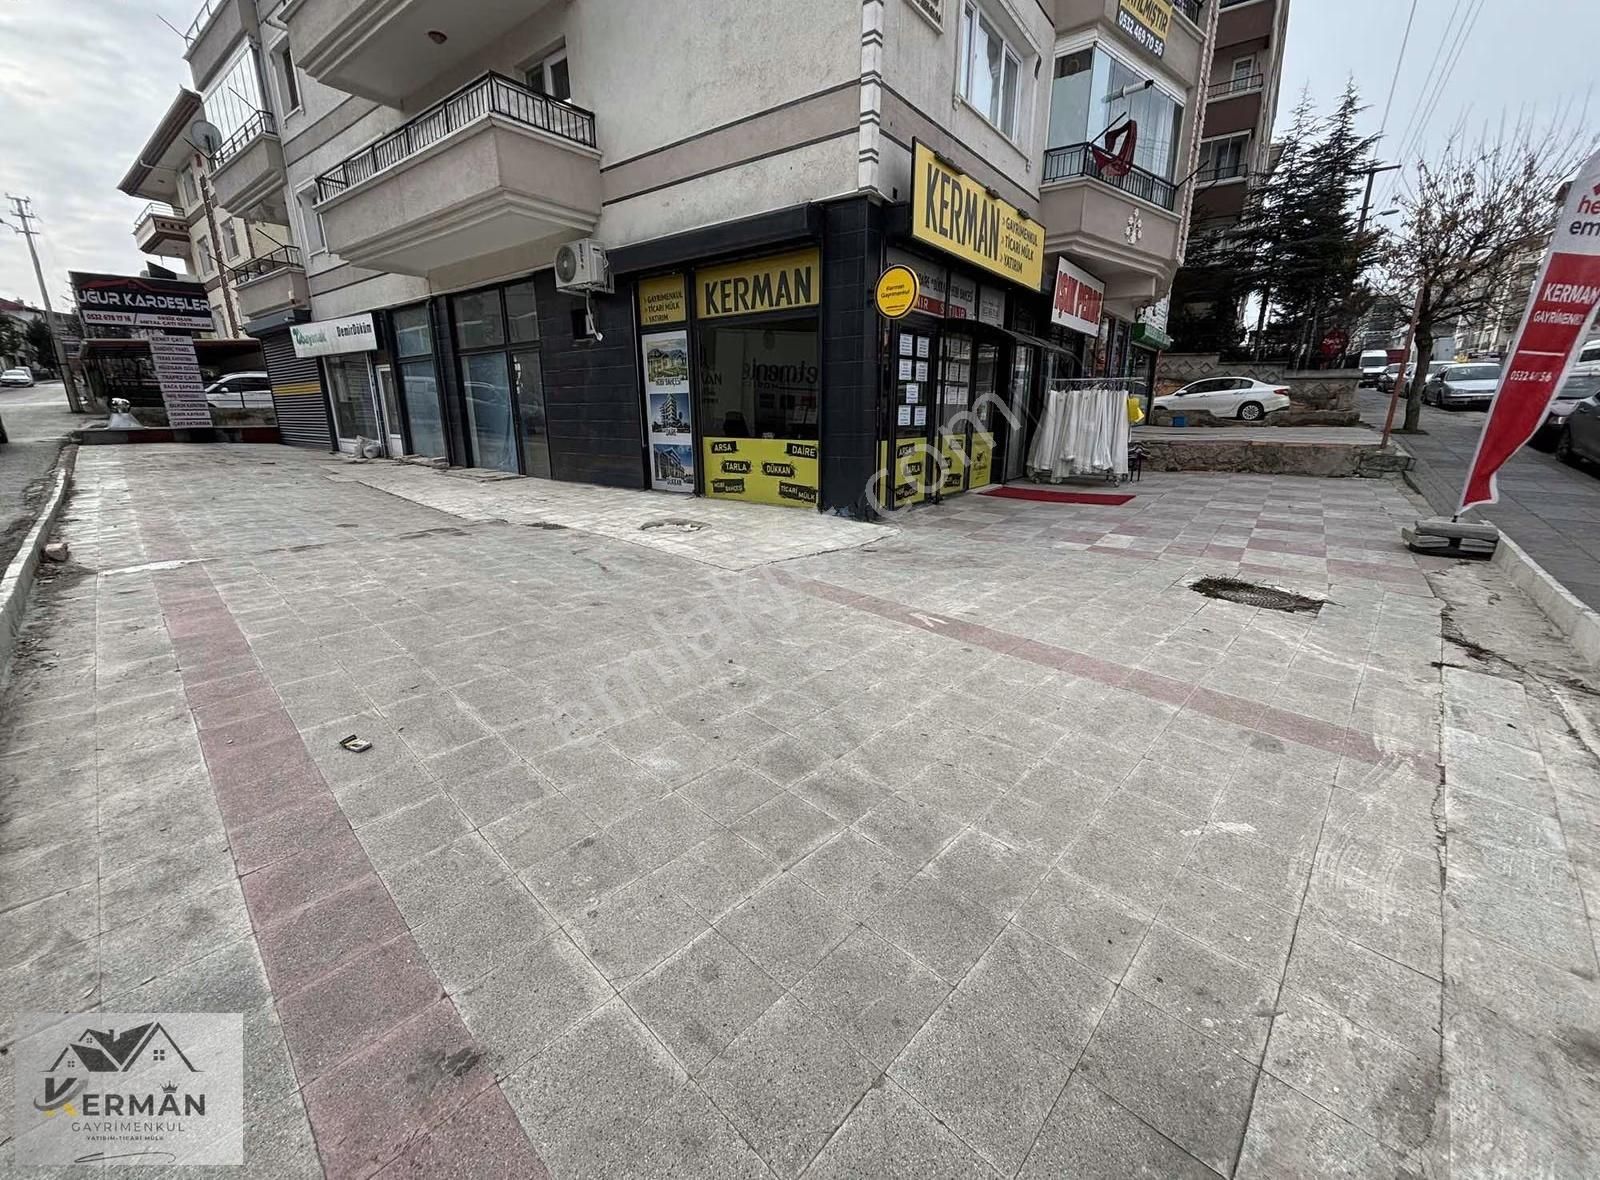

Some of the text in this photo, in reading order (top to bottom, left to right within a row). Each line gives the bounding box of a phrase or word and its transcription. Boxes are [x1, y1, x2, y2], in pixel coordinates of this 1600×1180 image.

[1119, 10, 1164, 57] 0532 469 70 56
[925, 162, 1001, 262] KERMAN
[1577, 194, 1600, 214] he
[1569, 220, 1600, 237] em
[704, 266, 812, 316] KERMAN
[78, 288, 211, 312] UĞUR KARDEŞLER
[335, 321, 373, 337] DemirDöküm
[714, 443, 732, 452] ARSA
[791, 445, 816, 457] DAİRE
[725, 462, 747, 472] TARLA
[766, 463, 791, 475] DÜKKAN
[798, 490, 816, 501] MÜLK
